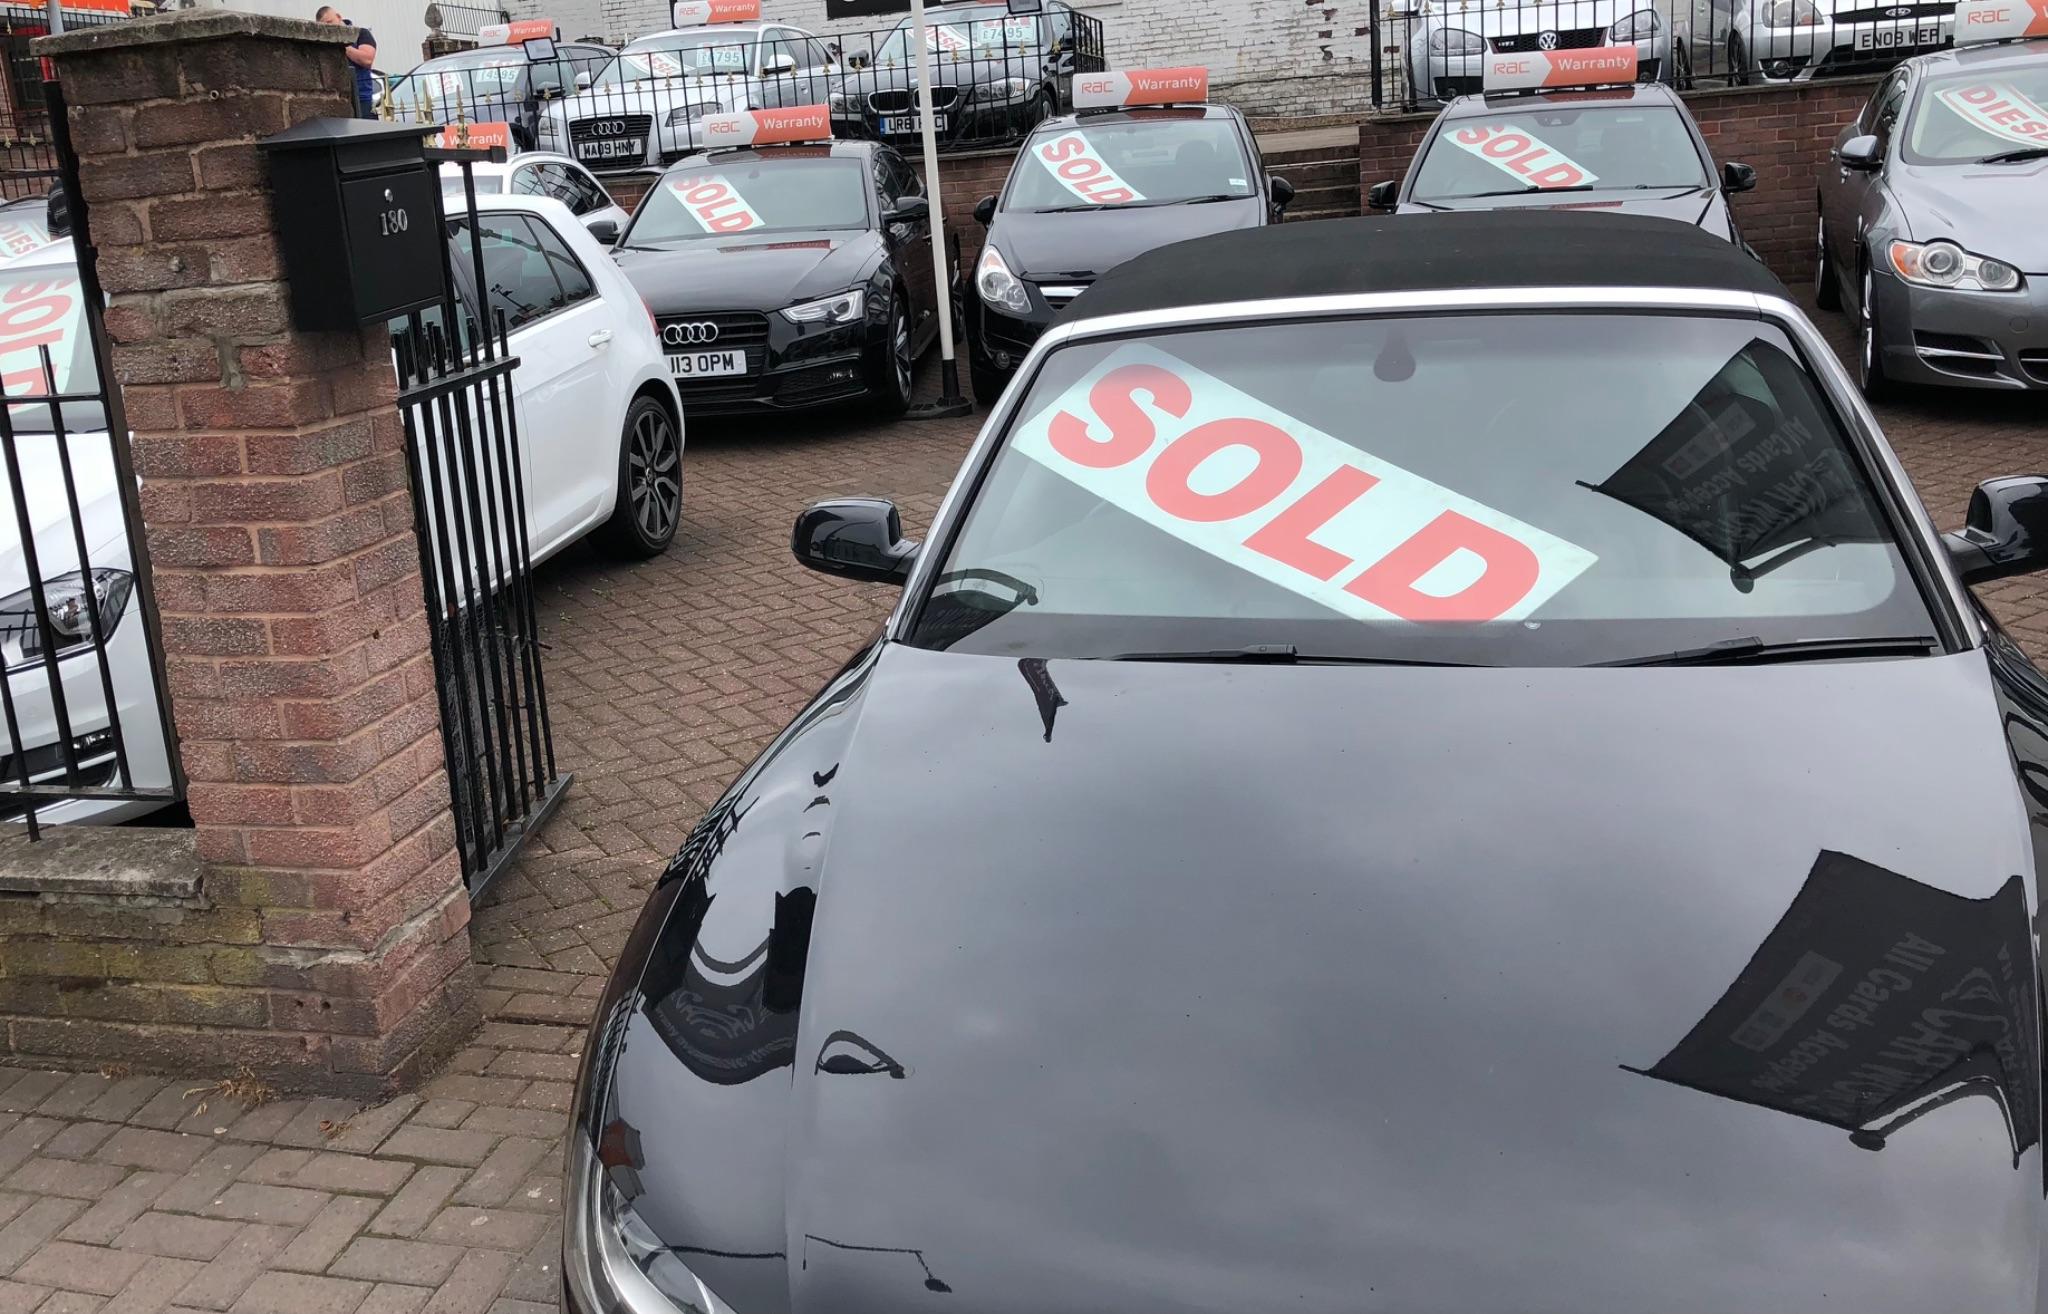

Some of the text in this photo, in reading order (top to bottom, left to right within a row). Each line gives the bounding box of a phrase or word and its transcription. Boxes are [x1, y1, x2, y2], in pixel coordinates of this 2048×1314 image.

[715, 3, 756, 13] Warranty
[513, 24, 548, 34] Warranty
[1558, 55, 1631, 72] Warranty
[1137, 77, 1201, 90] Warranty
[763, 116, 824, 129] Warranty
[449, 133, 503, 146] Wrranty
[1456, 123, 1584, 188] SOLD
[1041, 137, 1134, 204] SOLD
[674, 174, 753, 233] SOLD
[380, 208, 408, 236] 180
[698, 353, 734, 372] OPM
[1047, 363, 1540, 625] SOLD
